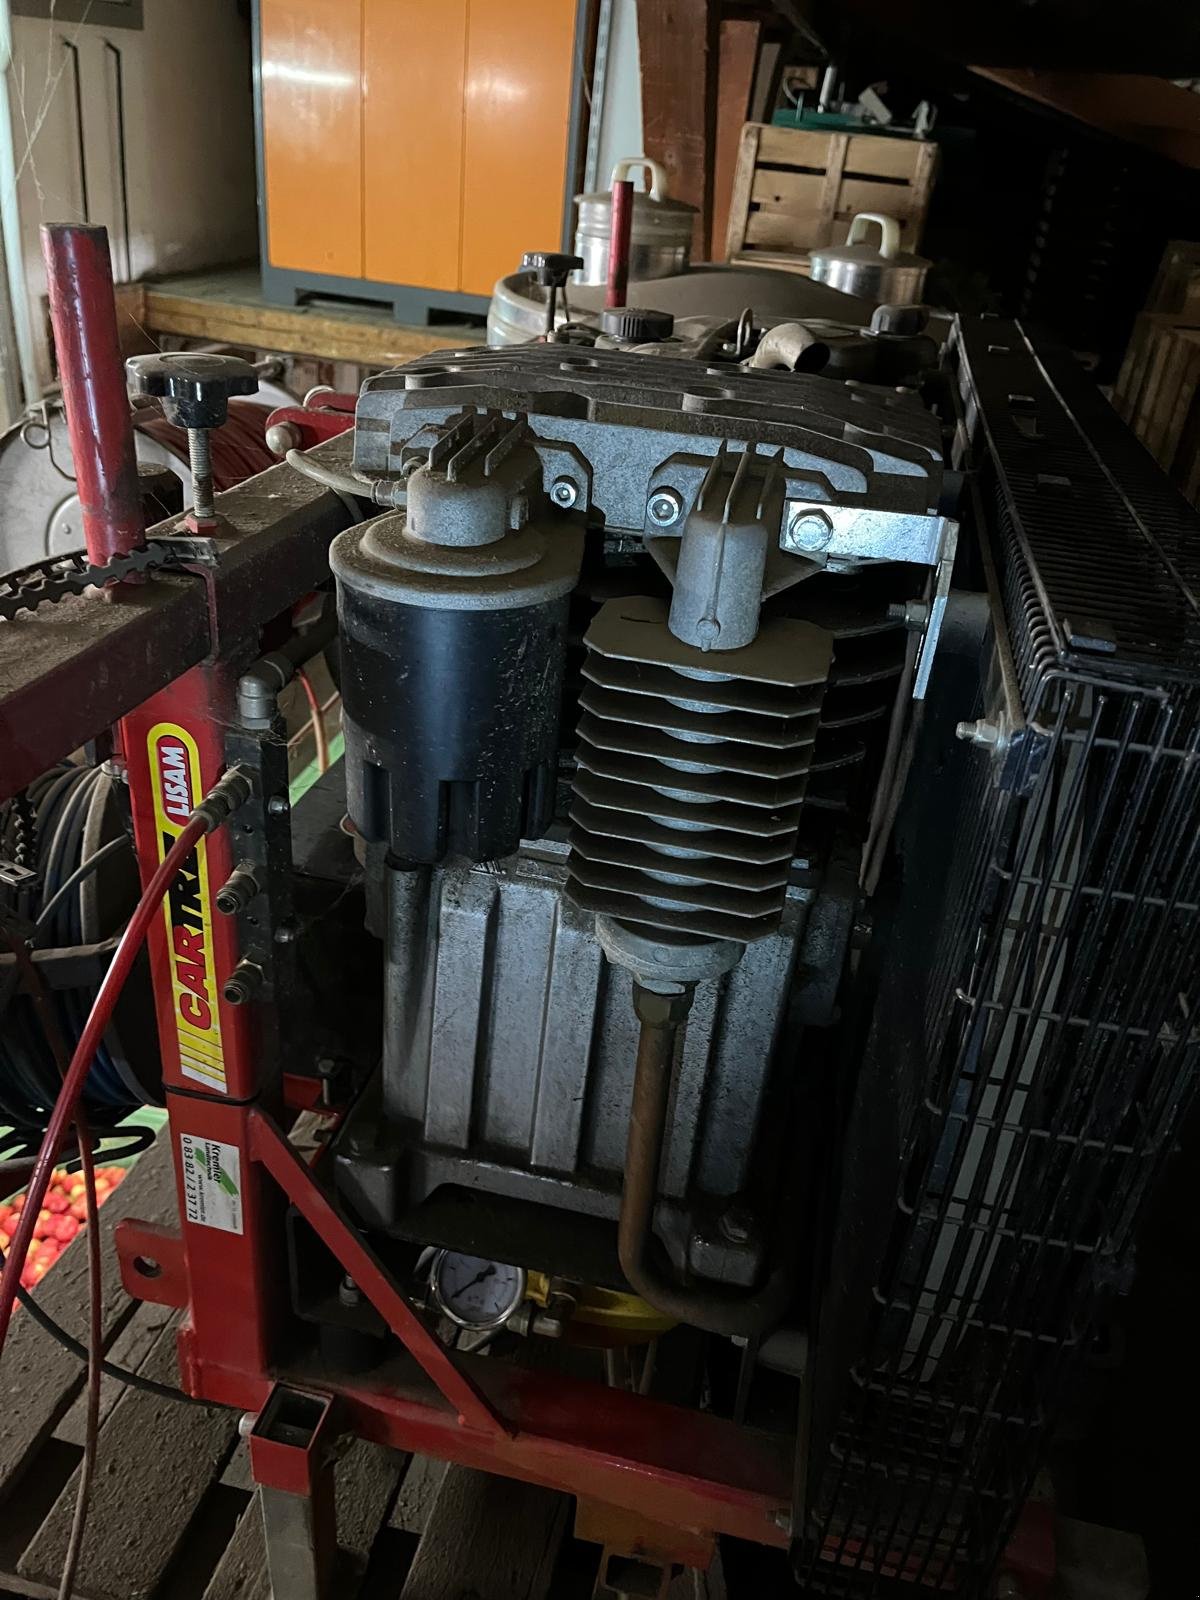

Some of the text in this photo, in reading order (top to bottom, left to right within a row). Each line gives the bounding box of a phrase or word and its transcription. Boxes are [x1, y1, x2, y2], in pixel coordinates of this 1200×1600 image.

[161, 746, 190, 817] LISAM
[183, 1146, 193, 1160] 83
[188, 1208, 198, 1220] 72
[211, 1144, 221, 1184] Kremler
